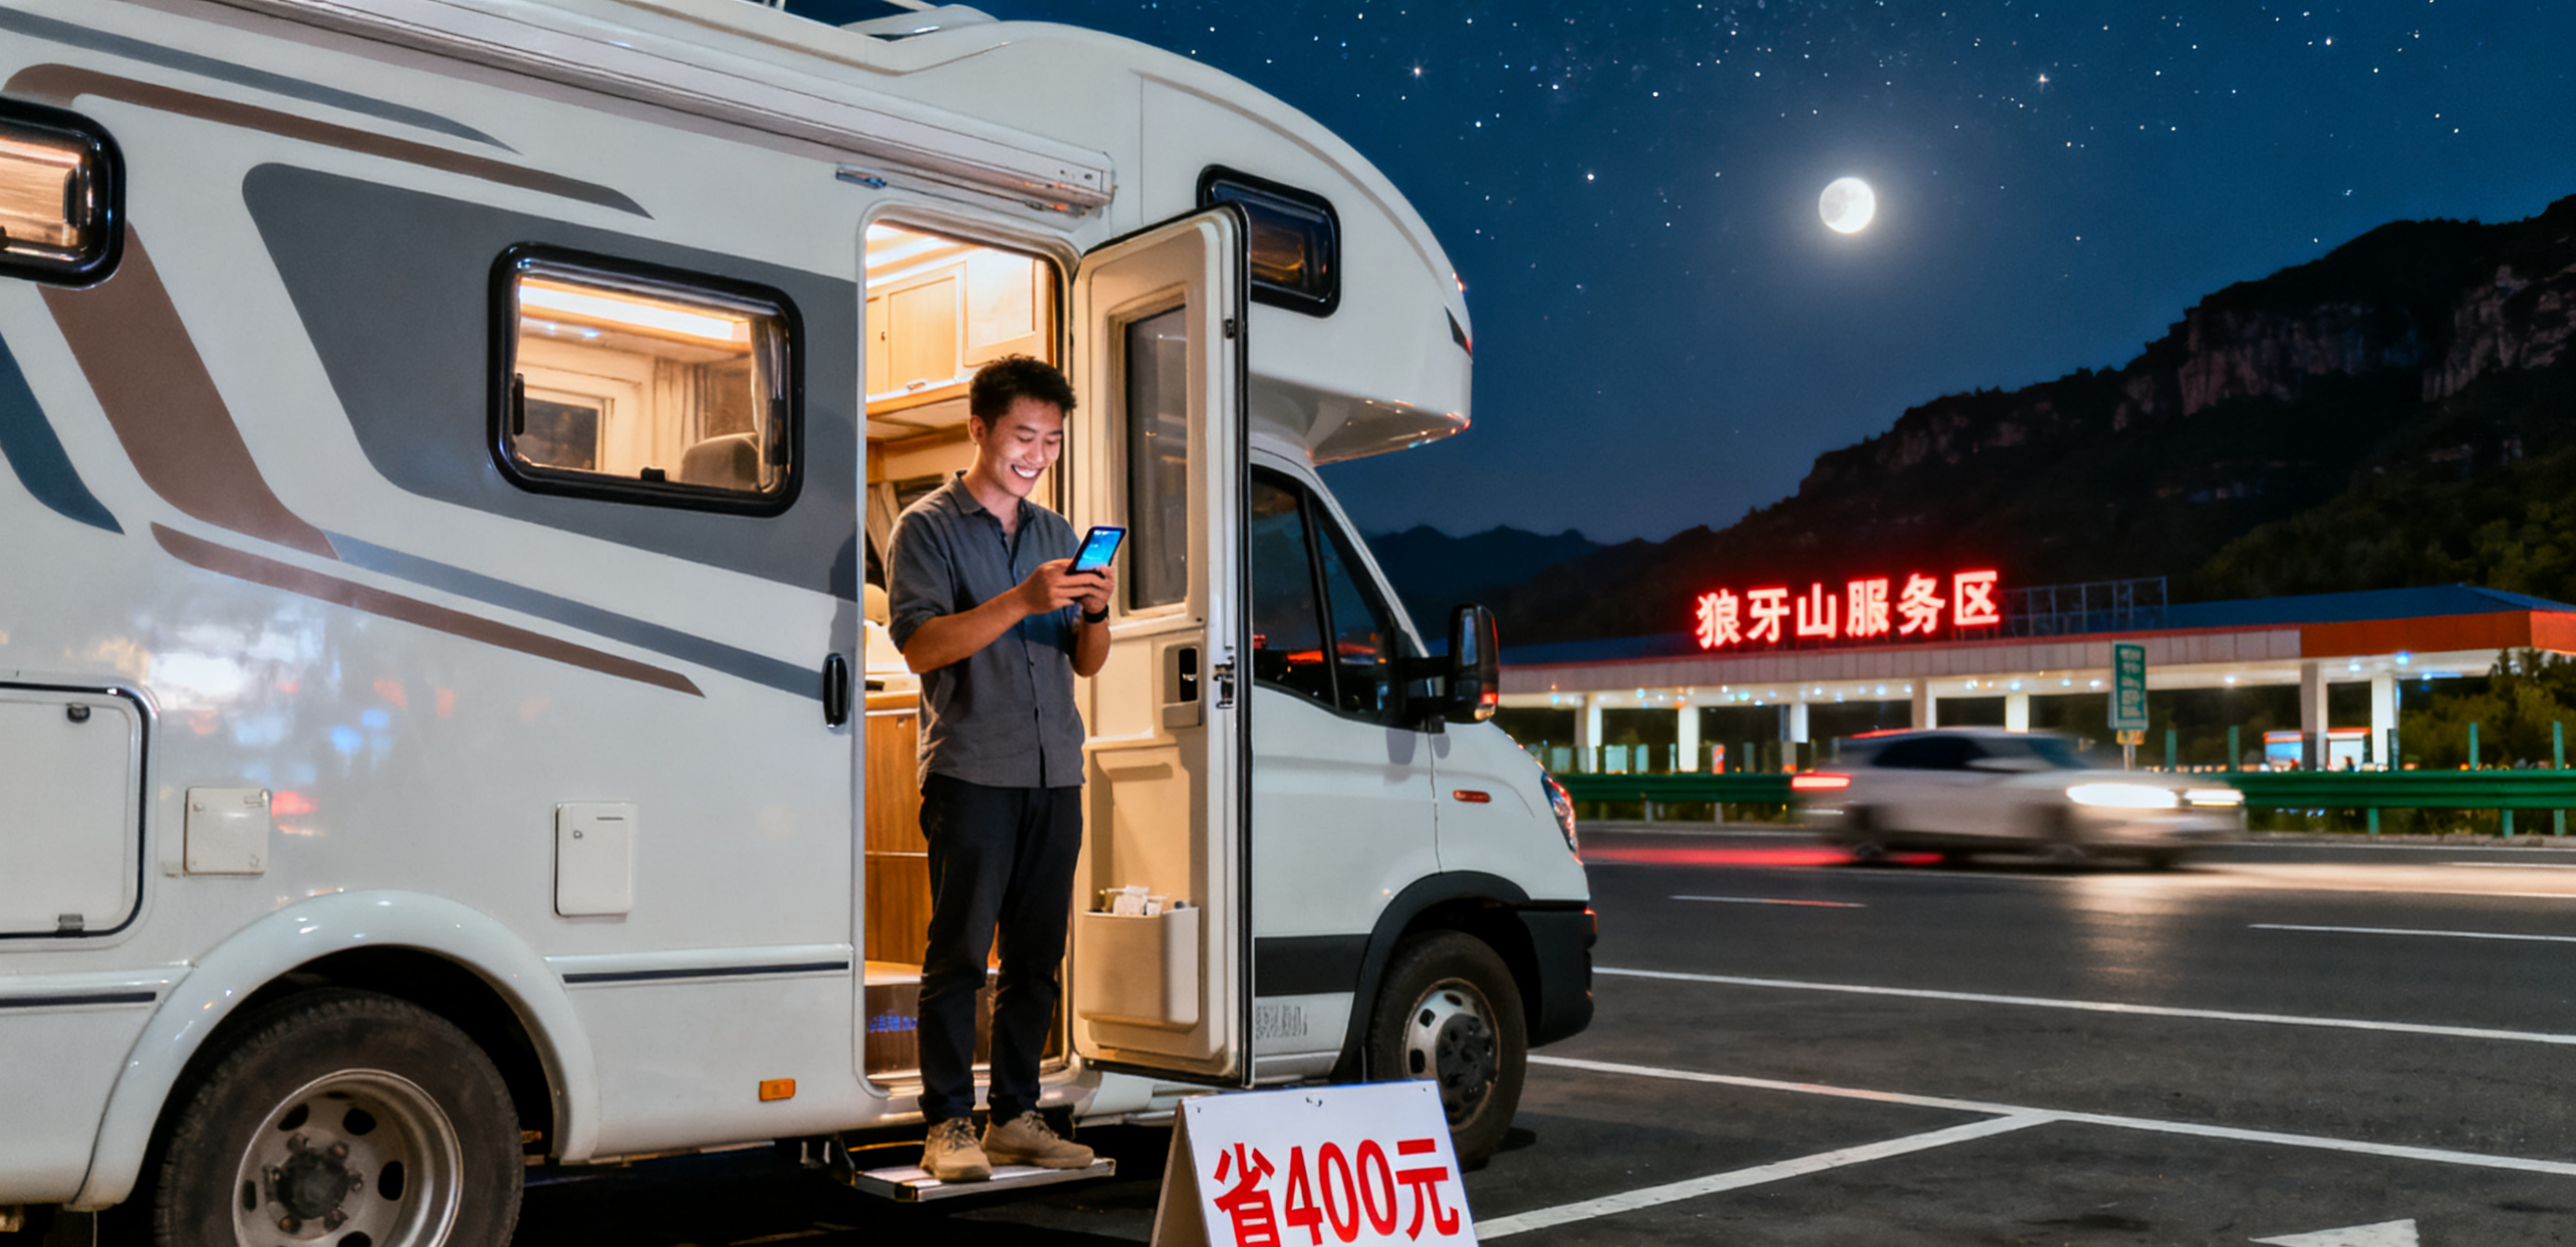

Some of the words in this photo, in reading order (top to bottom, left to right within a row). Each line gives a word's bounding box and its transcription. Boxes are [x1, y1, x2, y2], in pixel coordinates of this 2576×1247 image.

[1695, 570, 2000, 649] 狼牙山服务区
[1214, 1139, 1460, 1247] 省400元
